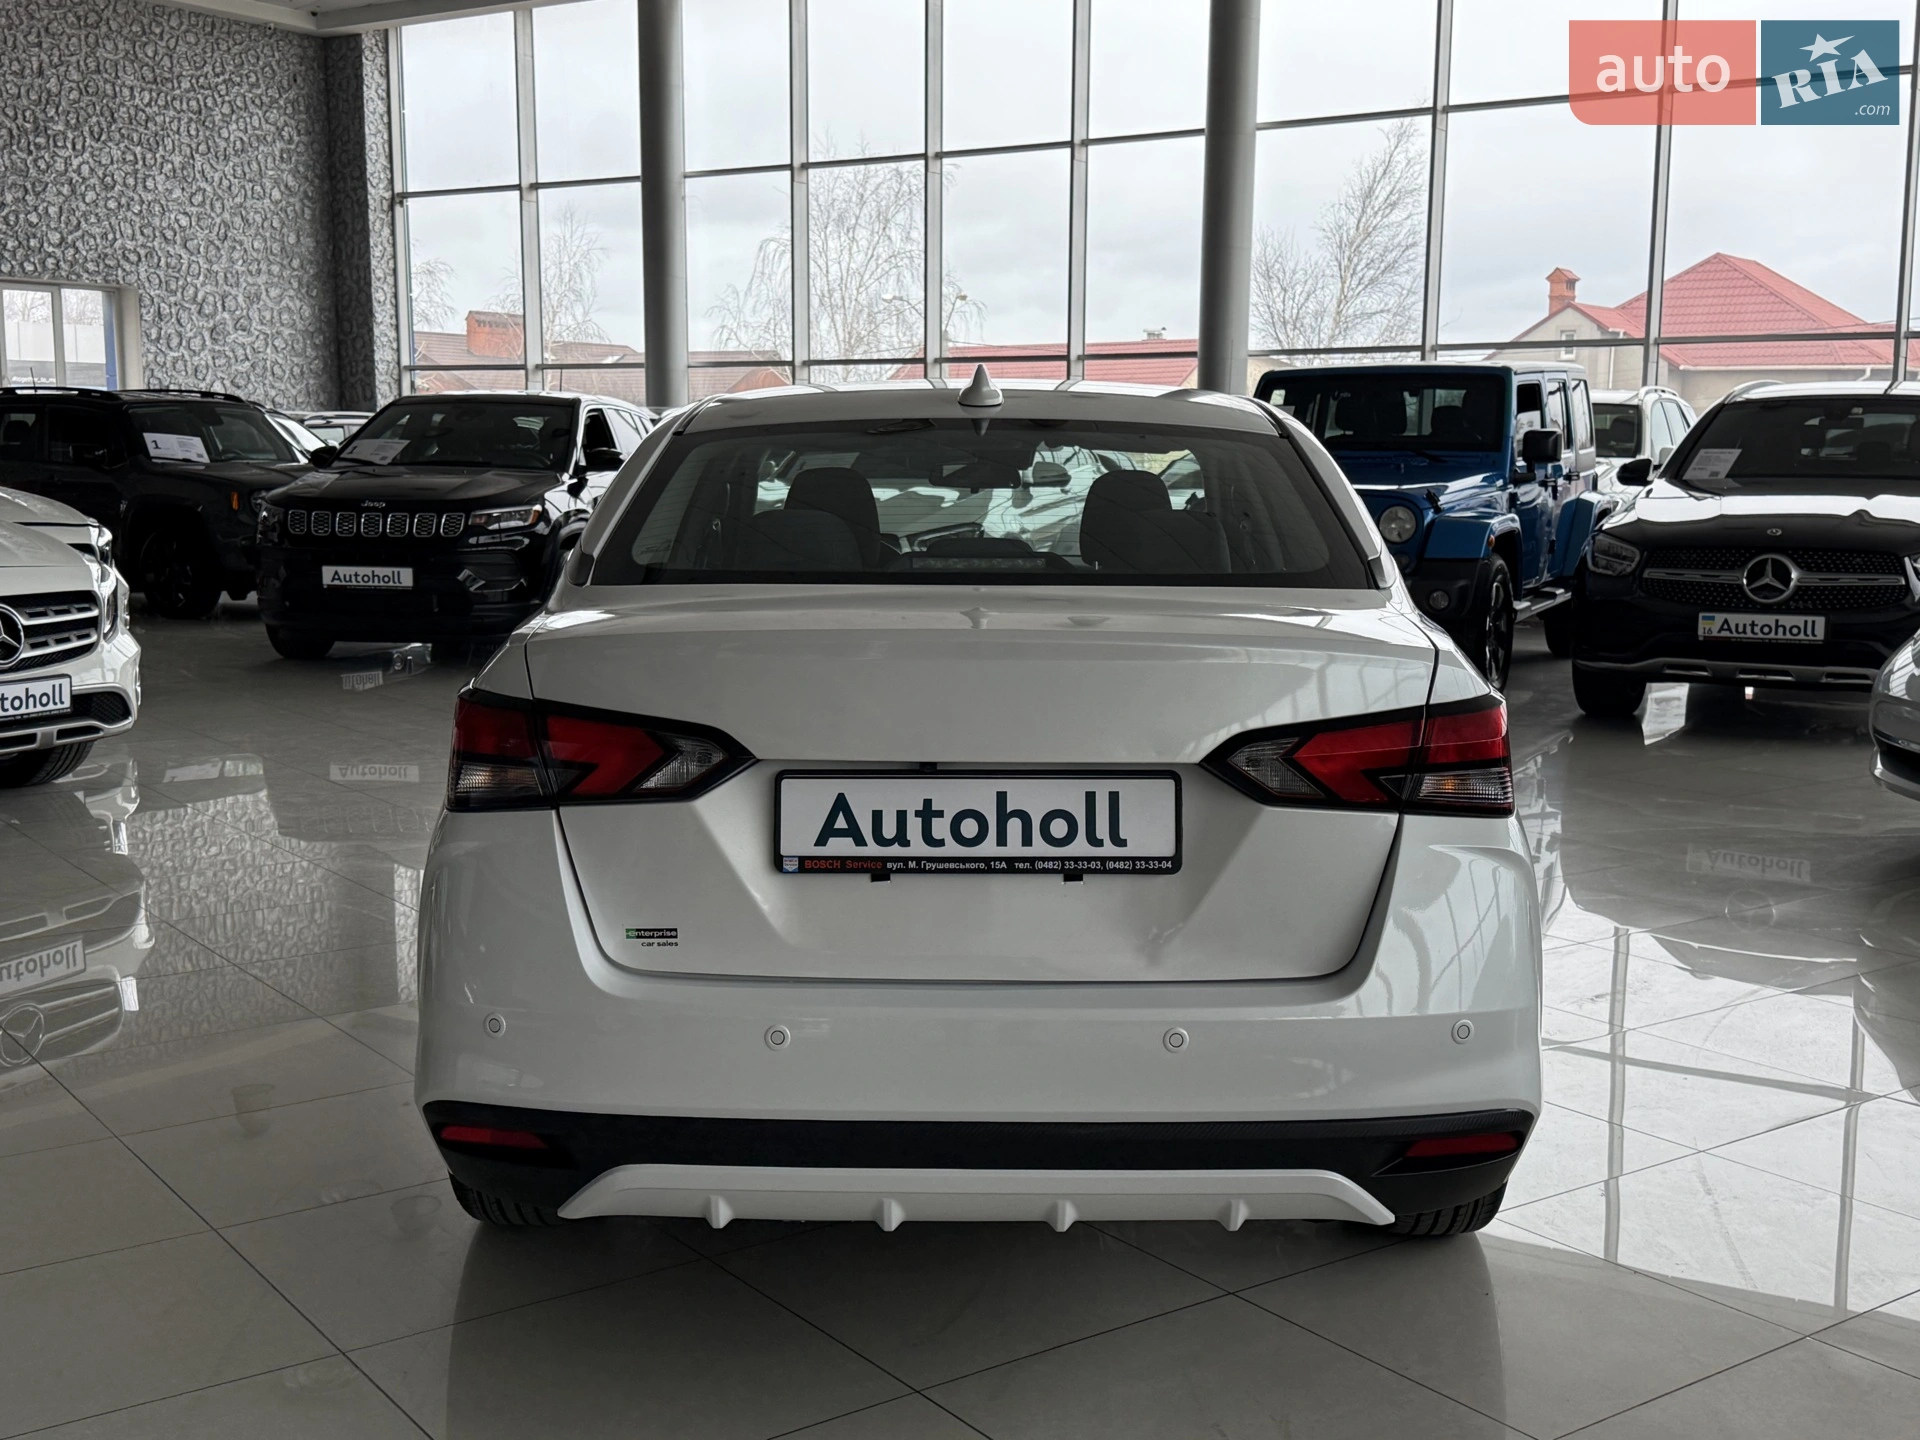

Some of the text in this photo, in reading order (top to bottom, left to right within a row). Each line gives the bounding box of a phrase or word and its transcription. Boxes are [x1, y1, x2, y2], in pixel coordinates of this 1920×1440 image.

[361, 500, 386, 509] Jeep
[330, 569, 403, 585] Autoholl
[1717, 617, 1818, 638] Autoholl
[813, 791, 1128, 848] Autoholl
[804, 860, 841, 869] BOSCH
[845, 860, 882, 869] Service
[886, 861, 906, 871] вул.
[921, 860, 988, 871] Грушевського,
[1014, 861, 1032, 869] тел.
[1034, 860, 1062, 871] (0482)
[1063, 860, 1103, 870] 33-33-03,
[1105, 860, 1133, 871] (0482)
[1135, 860, 1172, 869] 33-33-04
[627, 930, 677, 938] enterprise
